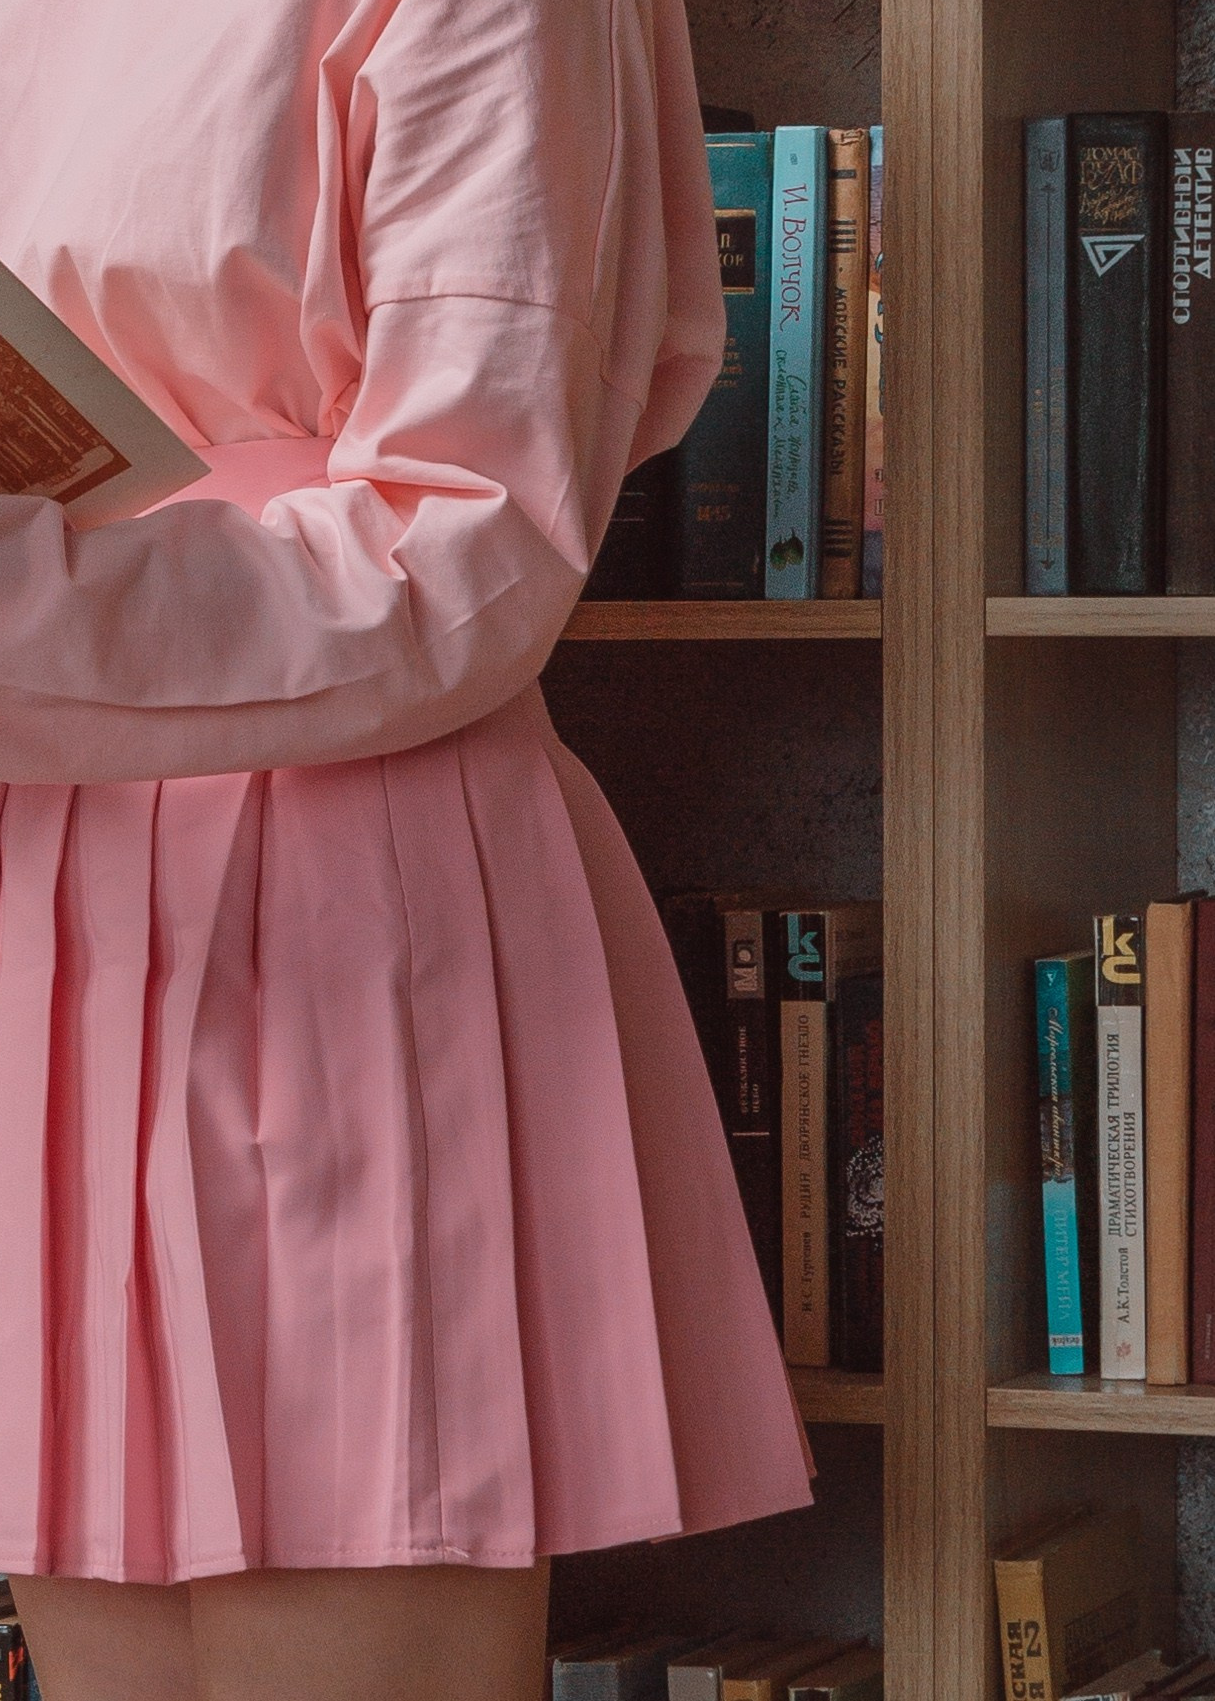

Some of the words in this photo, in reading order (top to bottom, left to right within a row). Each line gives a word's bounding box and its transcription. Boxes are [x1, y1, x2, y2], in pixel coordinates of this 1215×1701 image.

[782, 184, 809, 212] И.
[1171, 148, 1191, 325] СПОРТИВНЫЙ
[1193, 148, 1213, 279] ДЕТЕКТИВ
[831, 284, 848, 368] МОРСКИЕ
[829, 379, 847, 475] РАССКАЗЫ
[796, 1013, 810, 1067] ГНЕЗДО
[1105, 1034, 1121, 1111] ТРИЛОГИЯ
[798, 1070, 811, 1160] ДВОРЯНСКОЕ
[799, 1171, 812, 1218] РУДИН
[1105, 1116, 1122, 1239] ДРАМАТИЧЕСКАЯ
[1121, 1112, 1139, 1239] СТИХОТВОРЕНИЯ
[1115, 1248, 1132, 1326] А.К.Толстой
